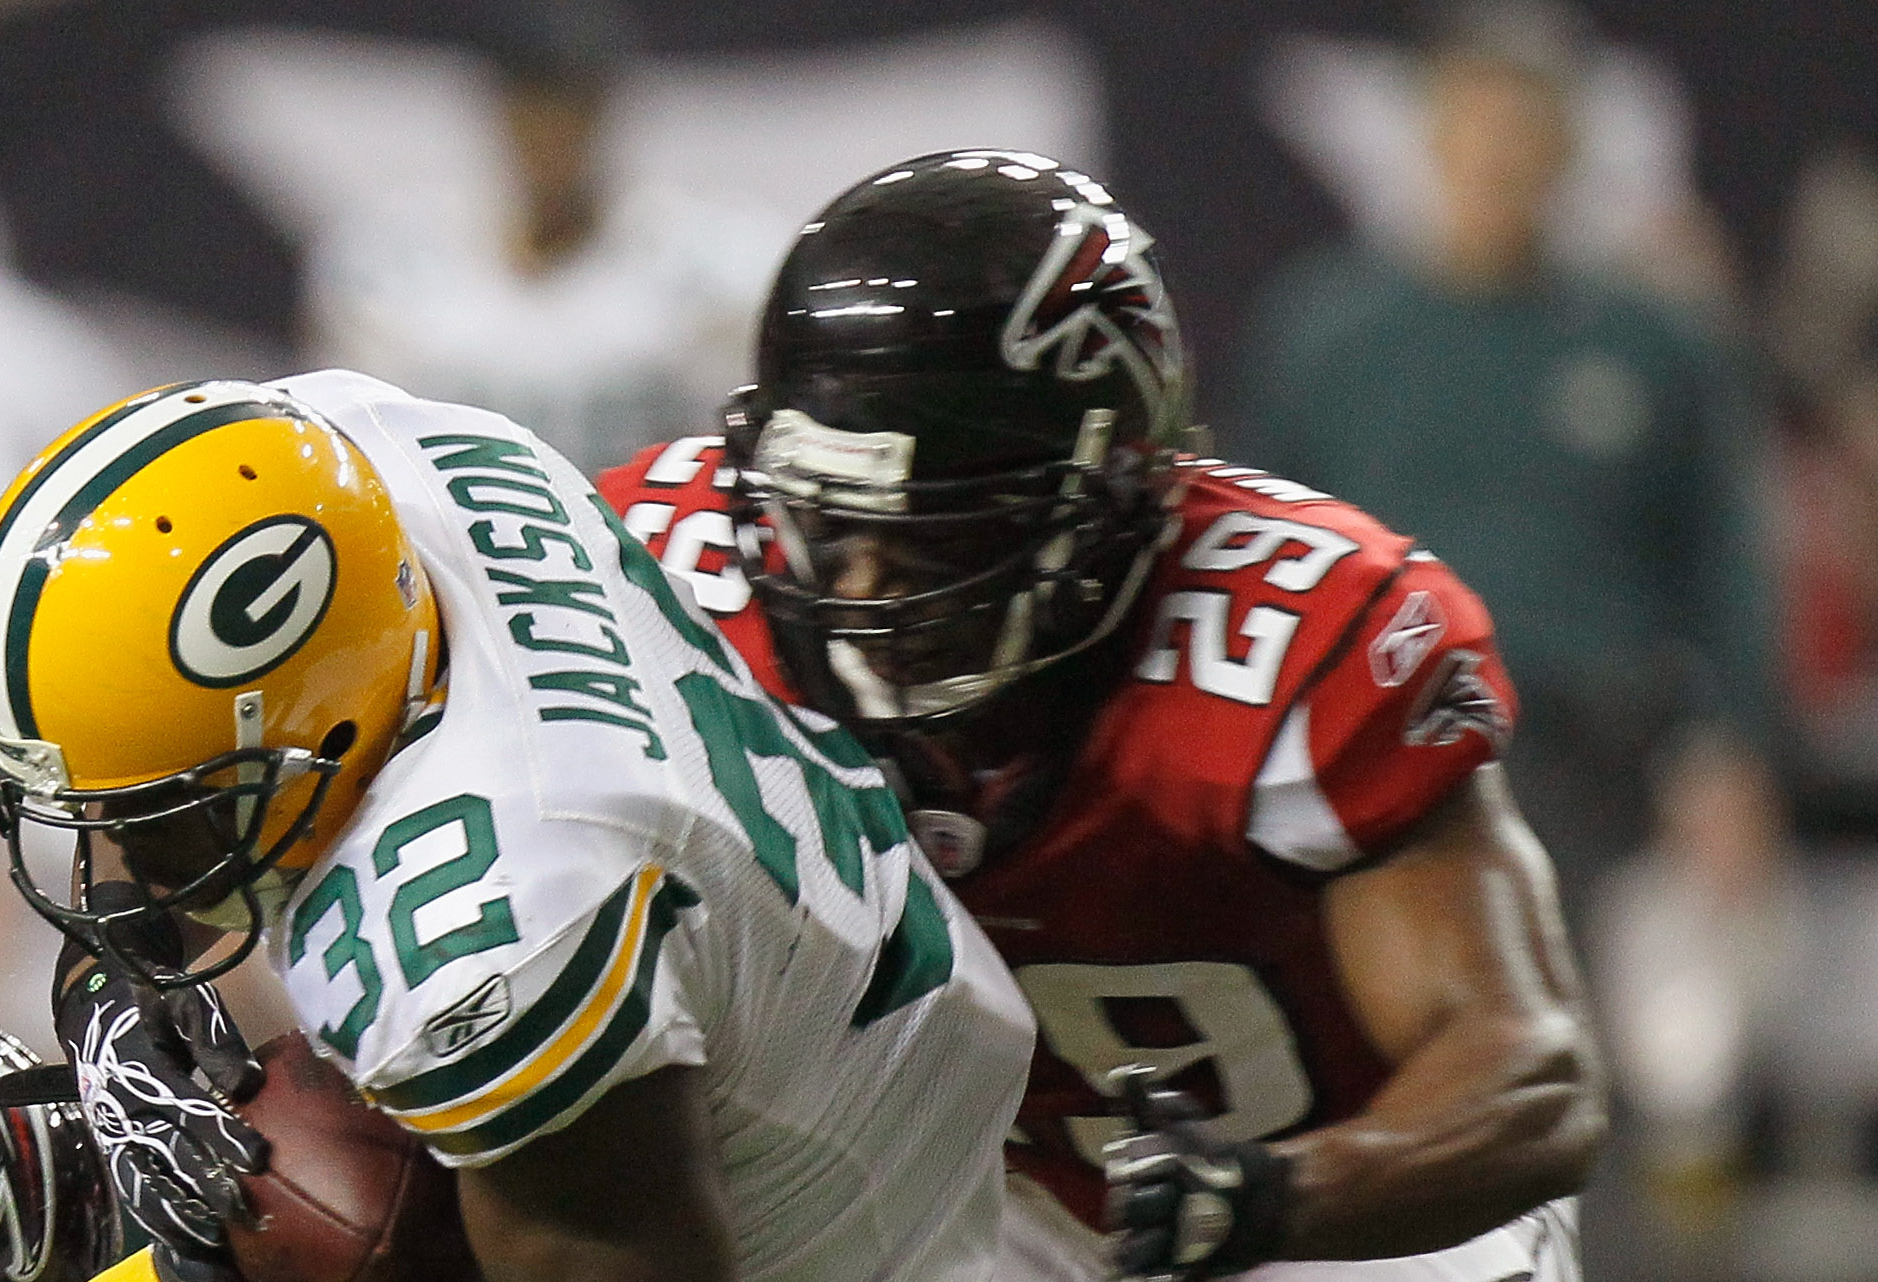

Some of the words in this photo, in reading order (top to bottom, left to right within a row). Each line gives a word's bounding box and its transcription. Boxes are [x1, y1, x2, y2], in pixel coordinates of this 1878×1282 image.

[172, 518, 336, 685] G
[419, 433, 669, 762] JACKSON
[1133, 510, 1361, 706] 29
[287, 793, 519, 1062] 32
